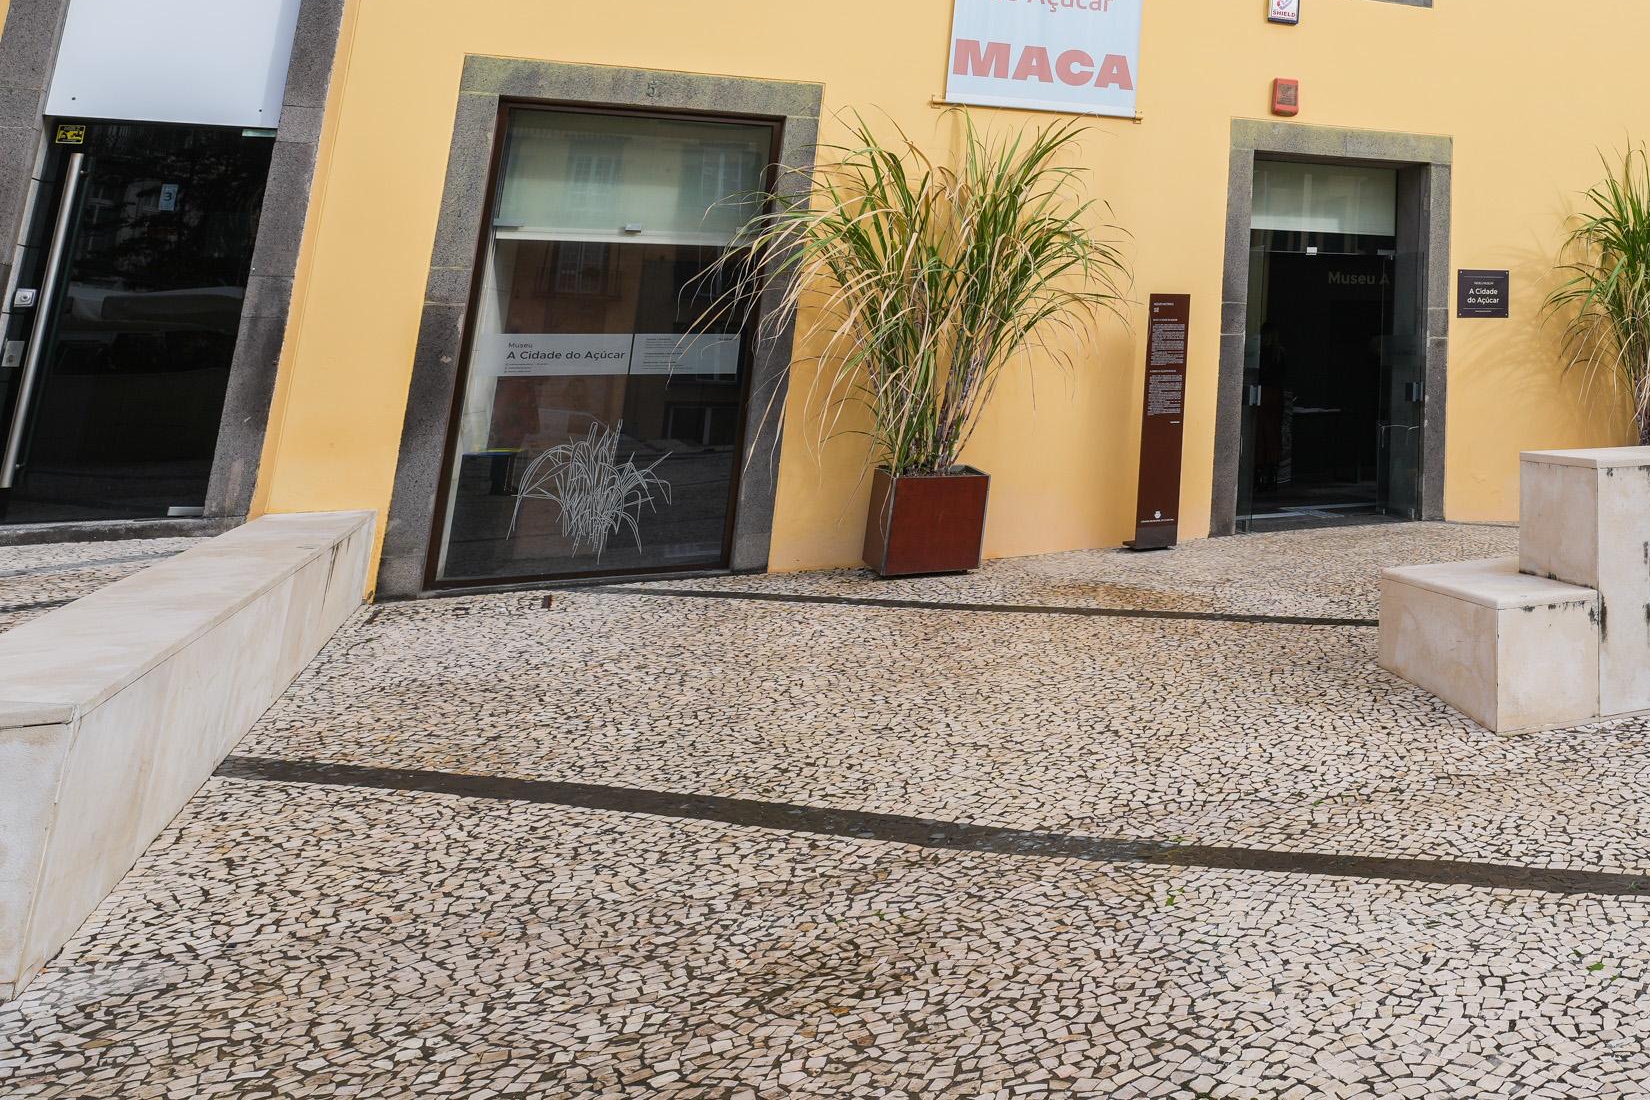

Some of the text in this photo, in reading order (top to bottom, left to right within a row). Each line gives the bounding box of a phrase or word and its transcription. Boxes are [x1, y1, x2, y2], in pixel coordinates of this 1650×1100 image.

[1272, 10, 1296, 18] SHIELD
[952, 38, 1134, 91] MACA
[1328, 271, 1376, 285] Museu
[1475, 287, 1498, 295] Cidade
[1467, 296, 1500, 305] do Açúcar
[506, 350, 626, 361] A Cidade do Açúcar
